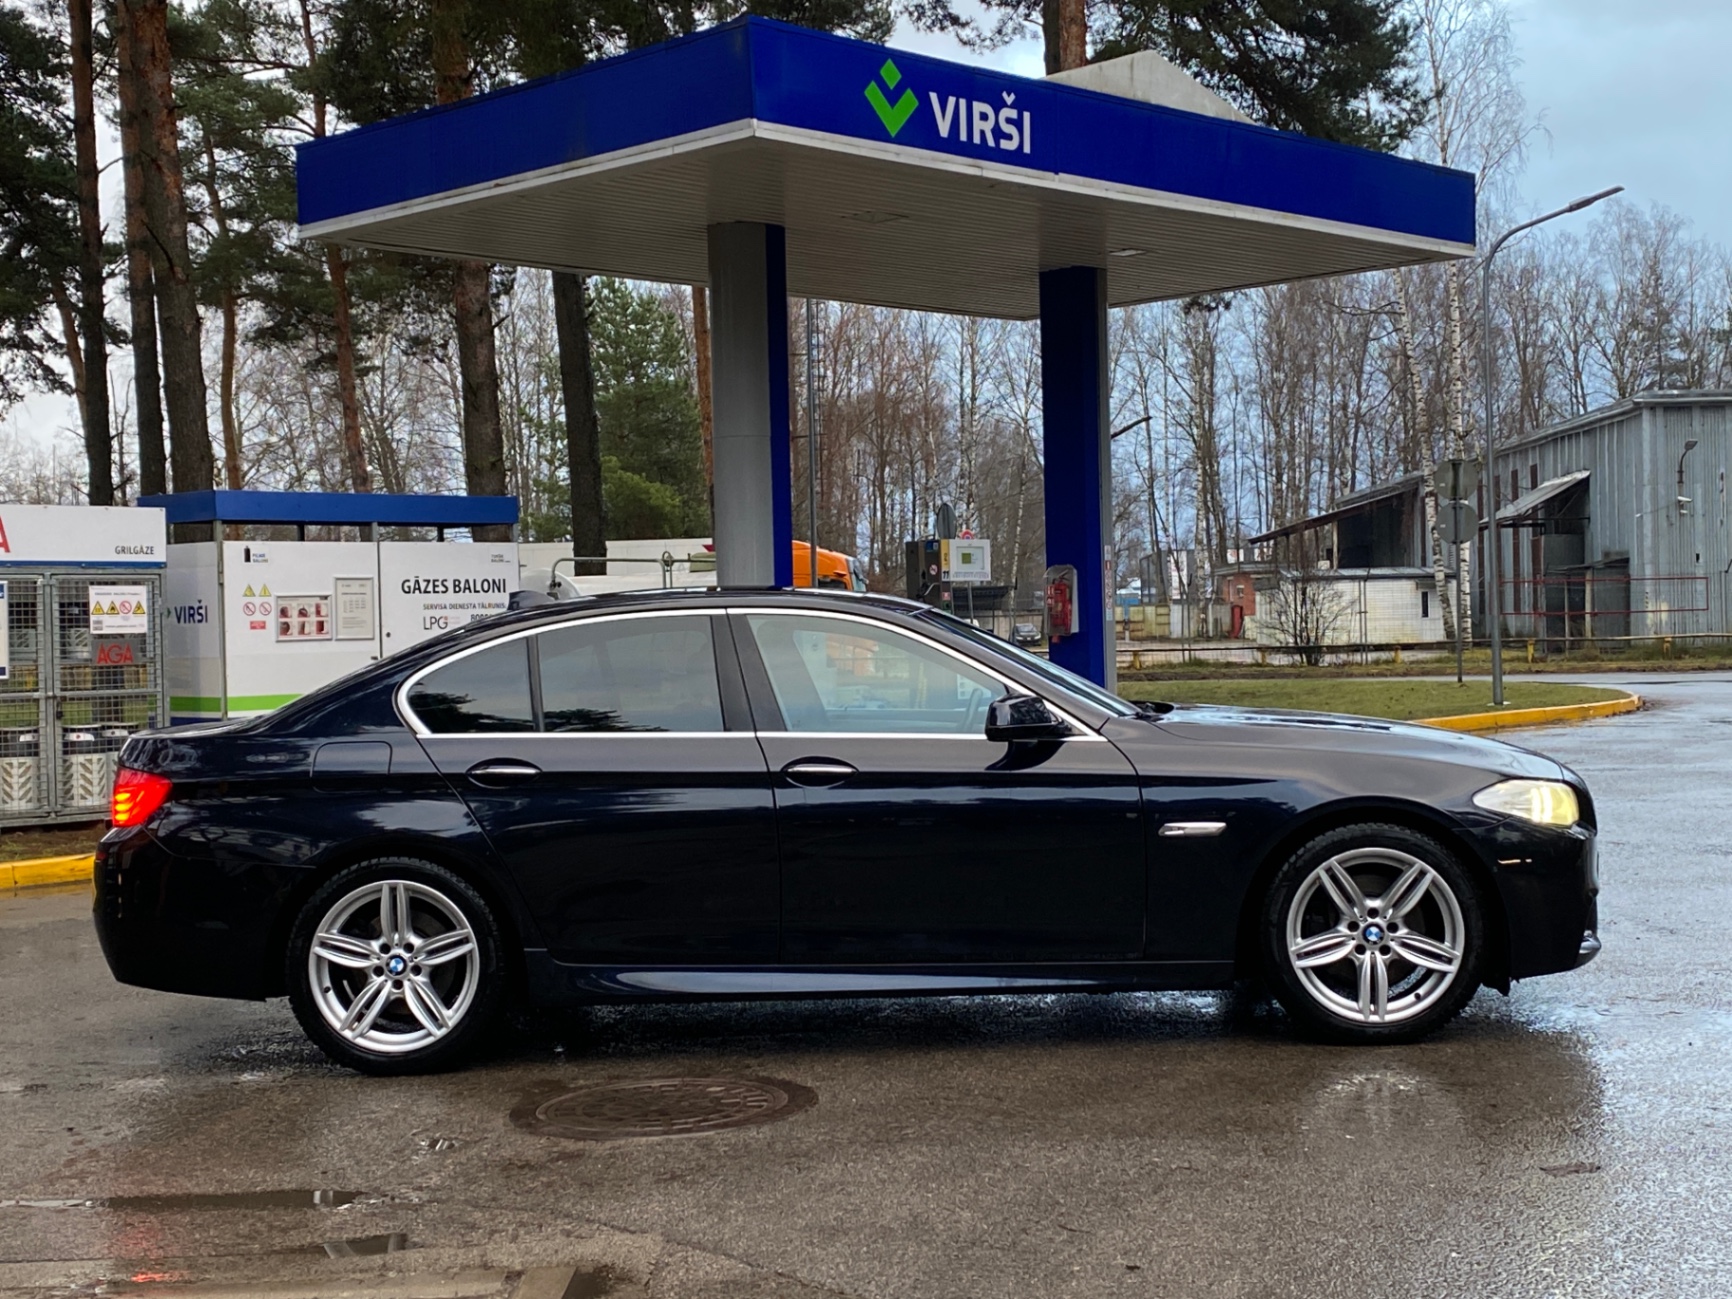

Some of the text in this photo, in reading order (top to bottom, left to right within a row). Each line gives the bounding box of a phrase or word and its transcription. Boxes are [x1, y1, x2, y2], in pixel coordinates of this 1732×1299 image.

[928, 90, 1031, 154] VIRŠI
[401, 575, 506, 594] GĀZES BALONI
[174, 599, 208, 624] VIRŠI
[423, 616, 448, 630] LPG
[97, 644, 134, 664] AGA
